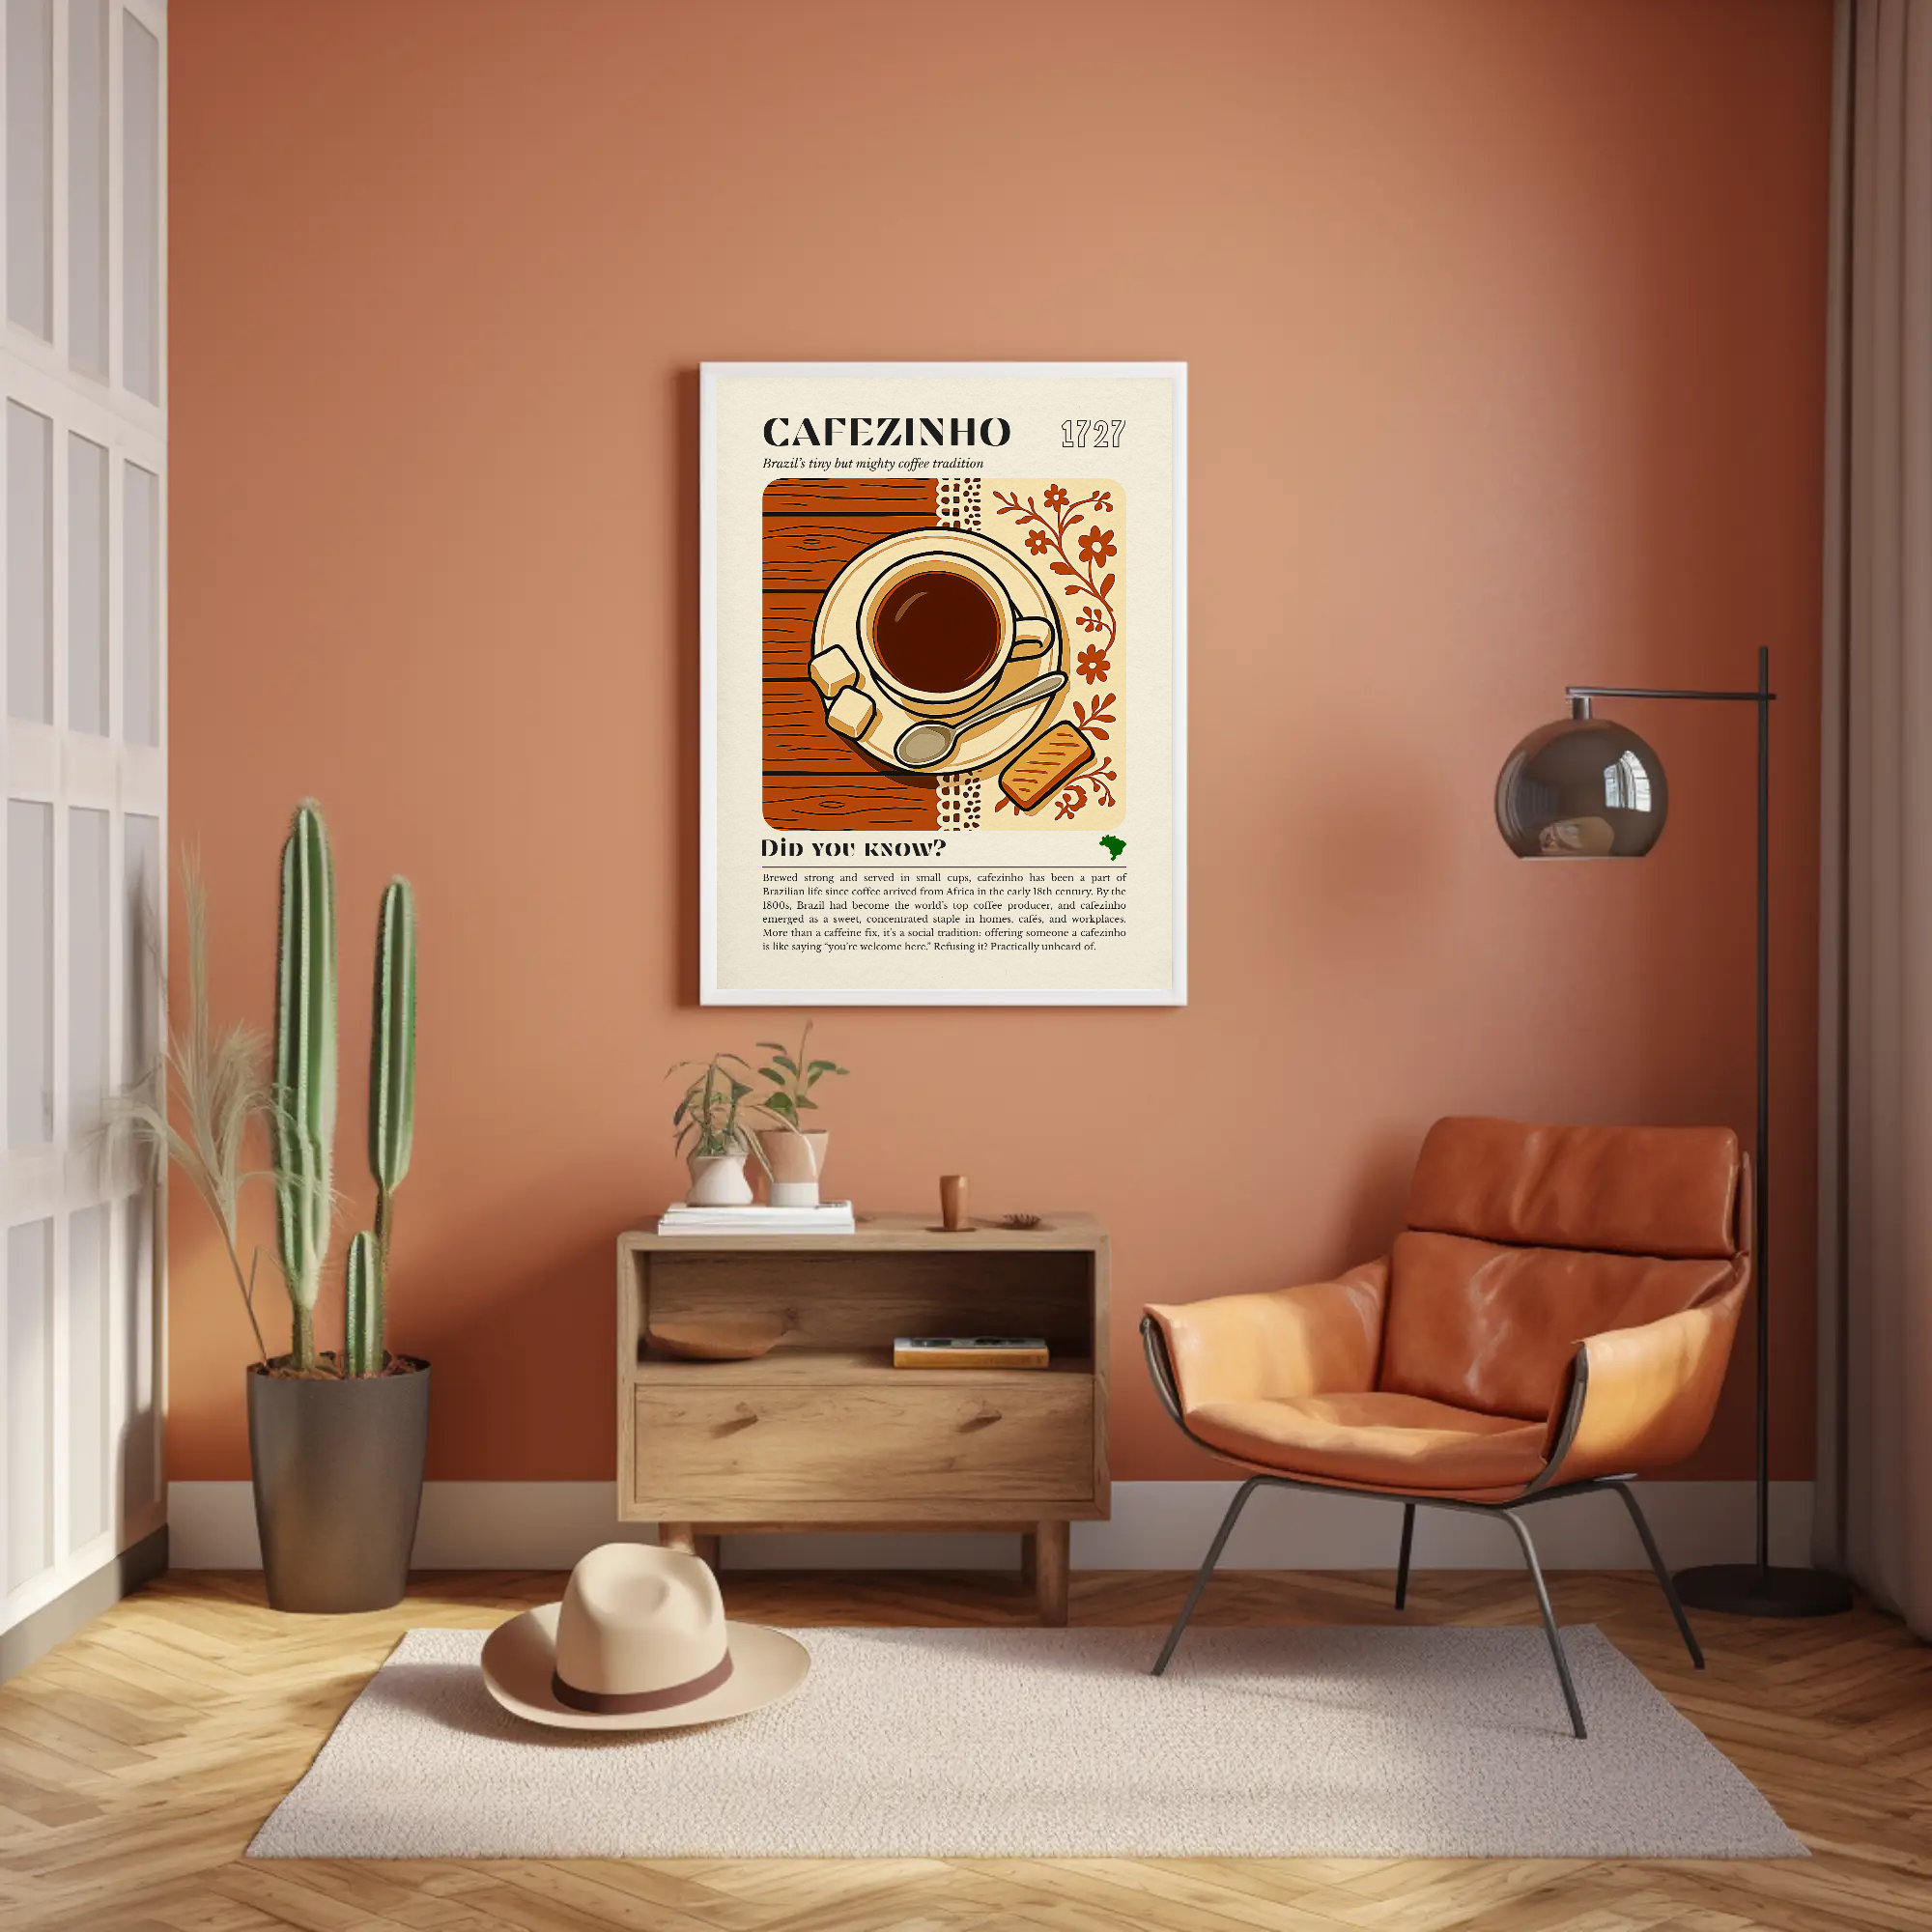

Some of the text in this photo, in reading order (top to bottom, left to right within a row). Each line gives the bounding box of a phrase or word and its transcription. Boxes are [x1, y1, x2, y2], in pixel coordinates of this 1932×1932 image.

[764, 418, 1010, 446] CAFEZINHO
[1062, 420, 1125, 447] 1727
[810, 458, 831, 471] tiny
[835, 458, 853, 469] but
[856, 458, 895, 471] mighty
[898, 458, 929, 471] coffee
[933, 458, 983, 469] tradition
[763, 872, 797, 882] Brewed
[805, 874, 834, 885] strong
[840, 872, 857, 882] and
[865, 872, 894, 882] served
[900, 872, 909, 882] in
[917, 872, 941, 882] small
[948, 875, 971, 885] cups,
[978, 872, 1023, 882] cafezinho
[1030, 872, 1044, 882] has
[1051, 872, 1073, 882] been
[1092, 874, 1110, 885] part
[1117, 872, 1127, 882] of
[763, 886, 1125, 898] Brazilian life since coffee arrived from Africa in the early 18th century. By the
[763, 900, 791, 911] 1800s,
[797, 900, 824, 910] Brazil
[830, 900, 847, 910] had
[852, 900, 889, 910] become
[895, 900, 909, 910] the
[953, 902, 968, 912] top
[974, 900, 1002, 910] coffee
[1009, 900, 1052, 912] producer,
[1058, 900, 1075, 910] and
[1081, 900, 1126, 910] cafezinho
[763, 914, 804, 925] emerged
[834, 915, 861, 924] sweet,
[867, 914, 928, 923] concentrated
[933, 914, 960, 925] staple
[965, 914, 975, 923] in
[980, 914, 1013, 924] homes,
[1019, 914, 1043, 924] cafés,
[1049, 914, 1066, 923] and
[1072, 914, 1125, 925] workplaces.
[763, 928, 787, 937] More
[791, 927, 811, 937] than
[824, 927, 861, 937] caffeine
[865, 927, 879, 938] fix,
[908, 927, 933, 937] social
[938, 927, 980, 937] tradition:
[985, 927, 1023, 940] offering
[1081, 927, 1126, 937] cafezinho
[763, 942, 769, 952] is
[774, 941, 788, 952] like
[792, 942, 822, 953] saying
[860, 941, 901, 952] welcome
[934, 941, 975, 953] Refusing
[978, 942, 987, 952] it?
[991, 941, 1039, 953] Practically
[1041, 941, 1081, 952] unheard
[1084, 941, 1095, 952] of.
